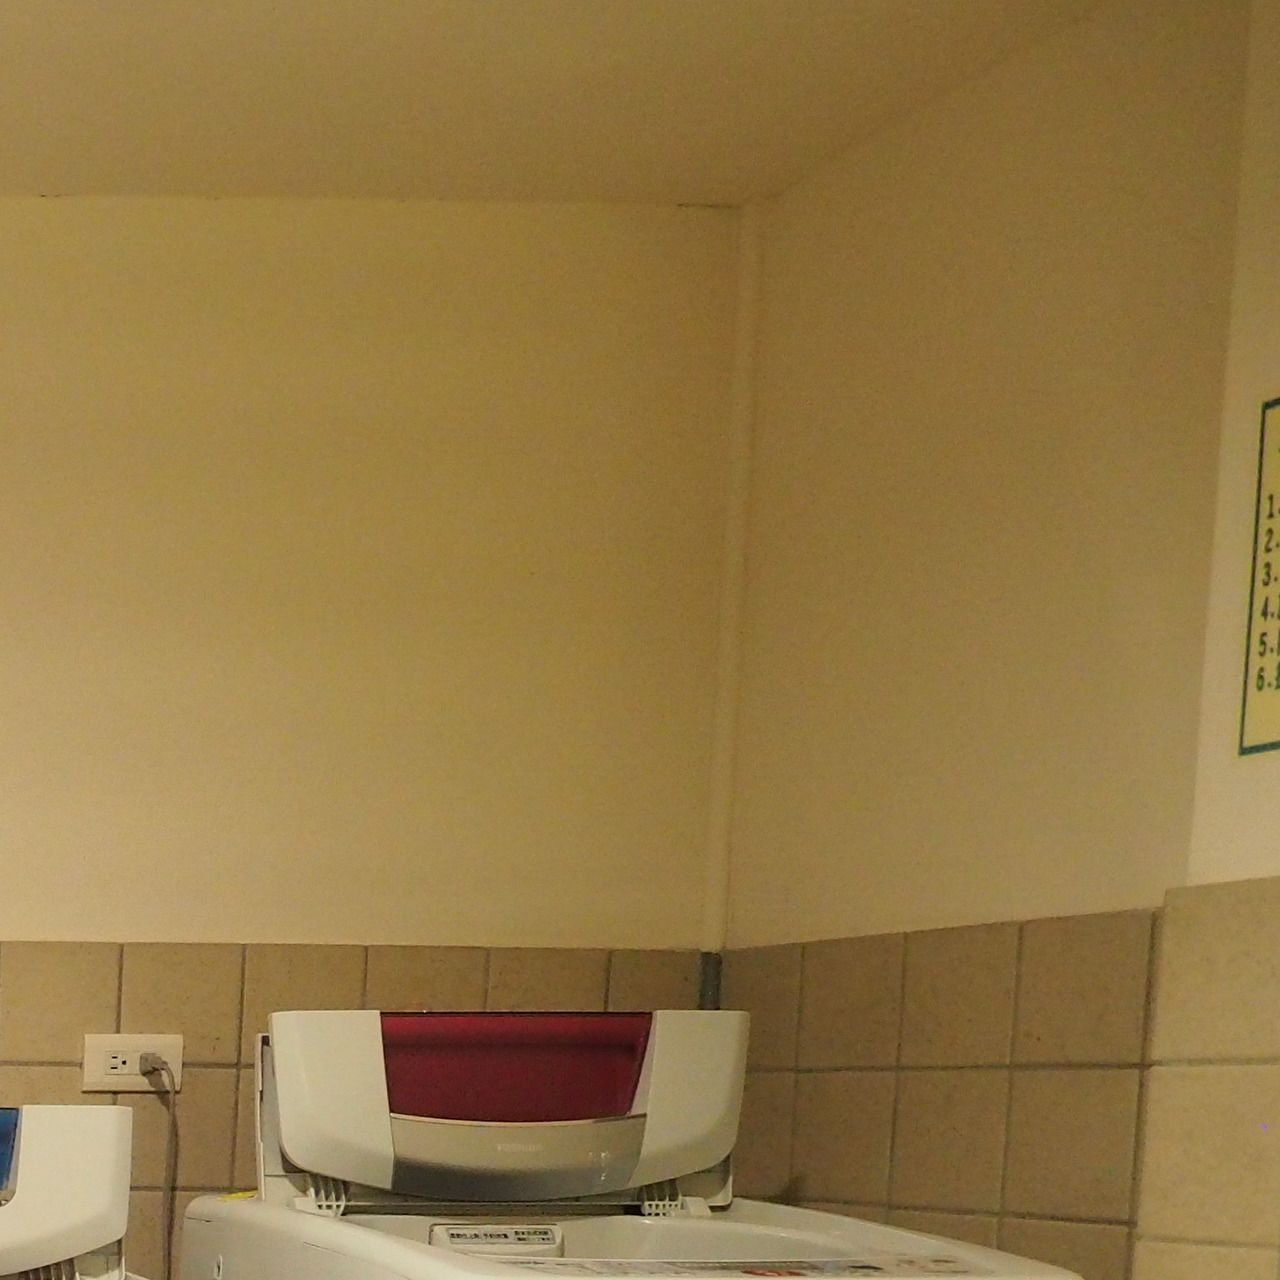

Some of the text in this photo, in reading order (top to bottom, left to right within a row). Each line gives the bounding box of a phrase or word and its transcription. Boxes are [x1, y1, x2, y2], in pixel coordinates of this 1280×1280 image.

[1264, 527, 1280, 553] 2.
[1262, 561, 1279, 587] 3.
[1260, 596, 1280, 622] 4.
[1258, 631, 1280, 658] 5.
